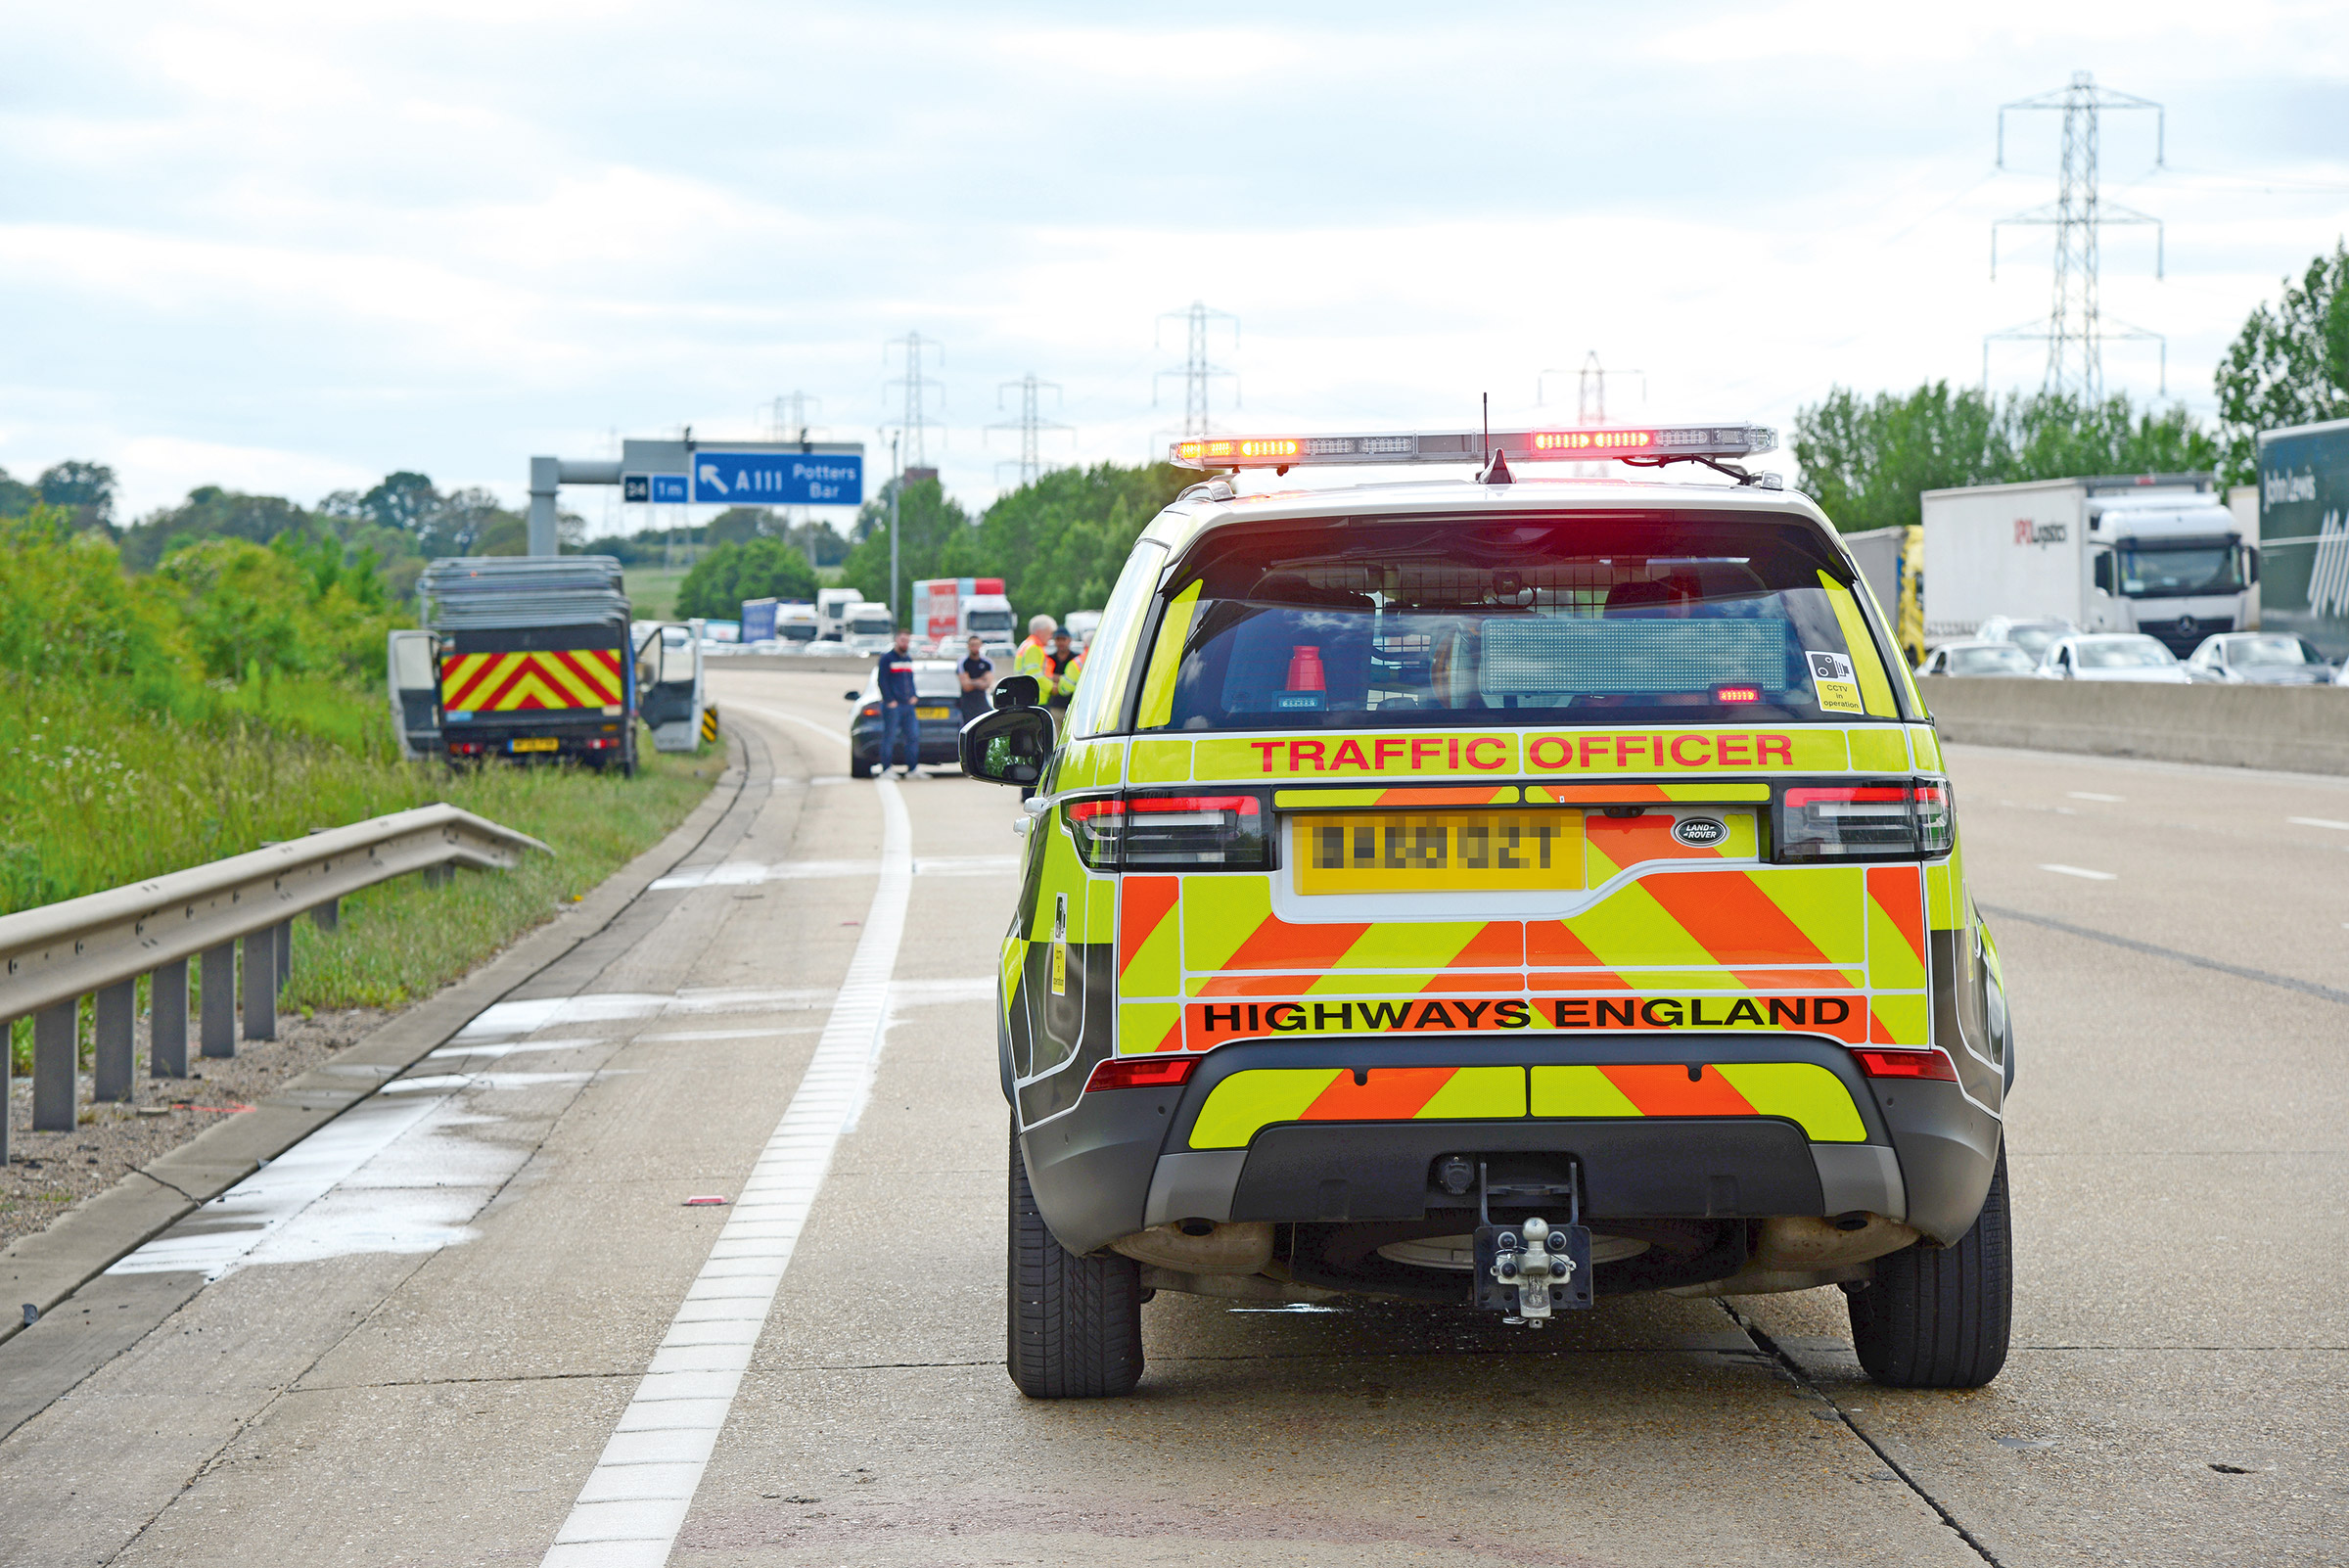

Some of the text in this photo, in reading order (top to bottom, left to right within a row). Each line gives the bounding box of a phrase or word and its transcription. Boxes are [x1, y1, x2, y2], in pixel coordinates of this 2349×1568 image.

[735, 470, 782, 492] A111
[793, 463, 856, 481] Potters
[626, 483, 647, 497] 24
[809, 484, 840, 498] Bar
[1823, 700, 1859, 709] operation
[1251, 734, 1793, 772] TRAFFIC OFFICER
[1204, 997, 1851, 1032] HIGHWAYS ENGLAND
